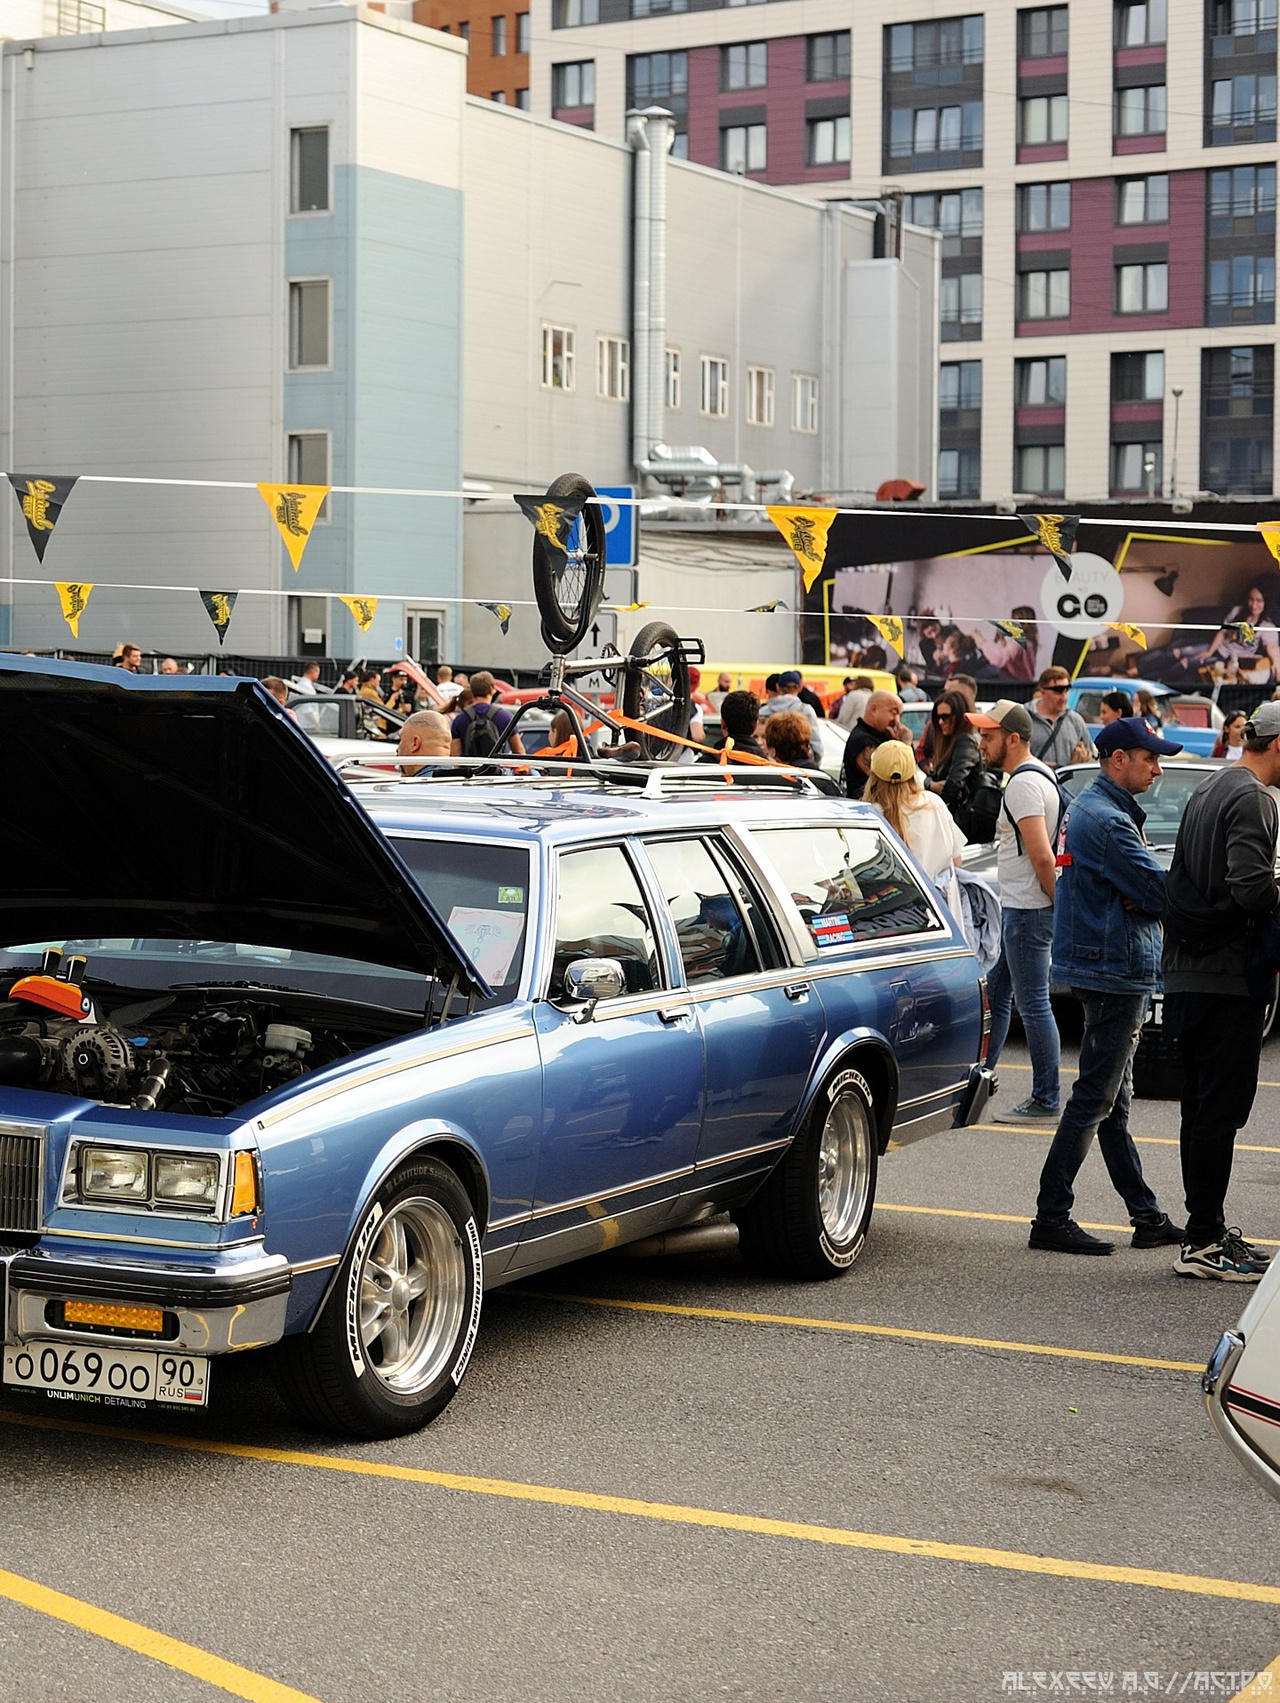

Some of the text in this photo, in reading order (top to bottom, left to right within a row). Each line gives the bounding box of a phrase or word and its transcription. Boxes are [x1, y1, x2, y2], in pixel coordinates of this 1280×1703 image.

[278, 492, 309, 537] Original
[1055, 571, 1110, 584] BAUTY
[832, 1071, 871, 1097] MICHELIN
[393, 1166, 428, 1187] LATITUDE
[348, 1214, 376, 1361] MICHELIN
[161, 1357, 195, 1387] 90
[104, 1396, 147, 1409] DETAILING
[158, 1386, 185, 1398] RUS
